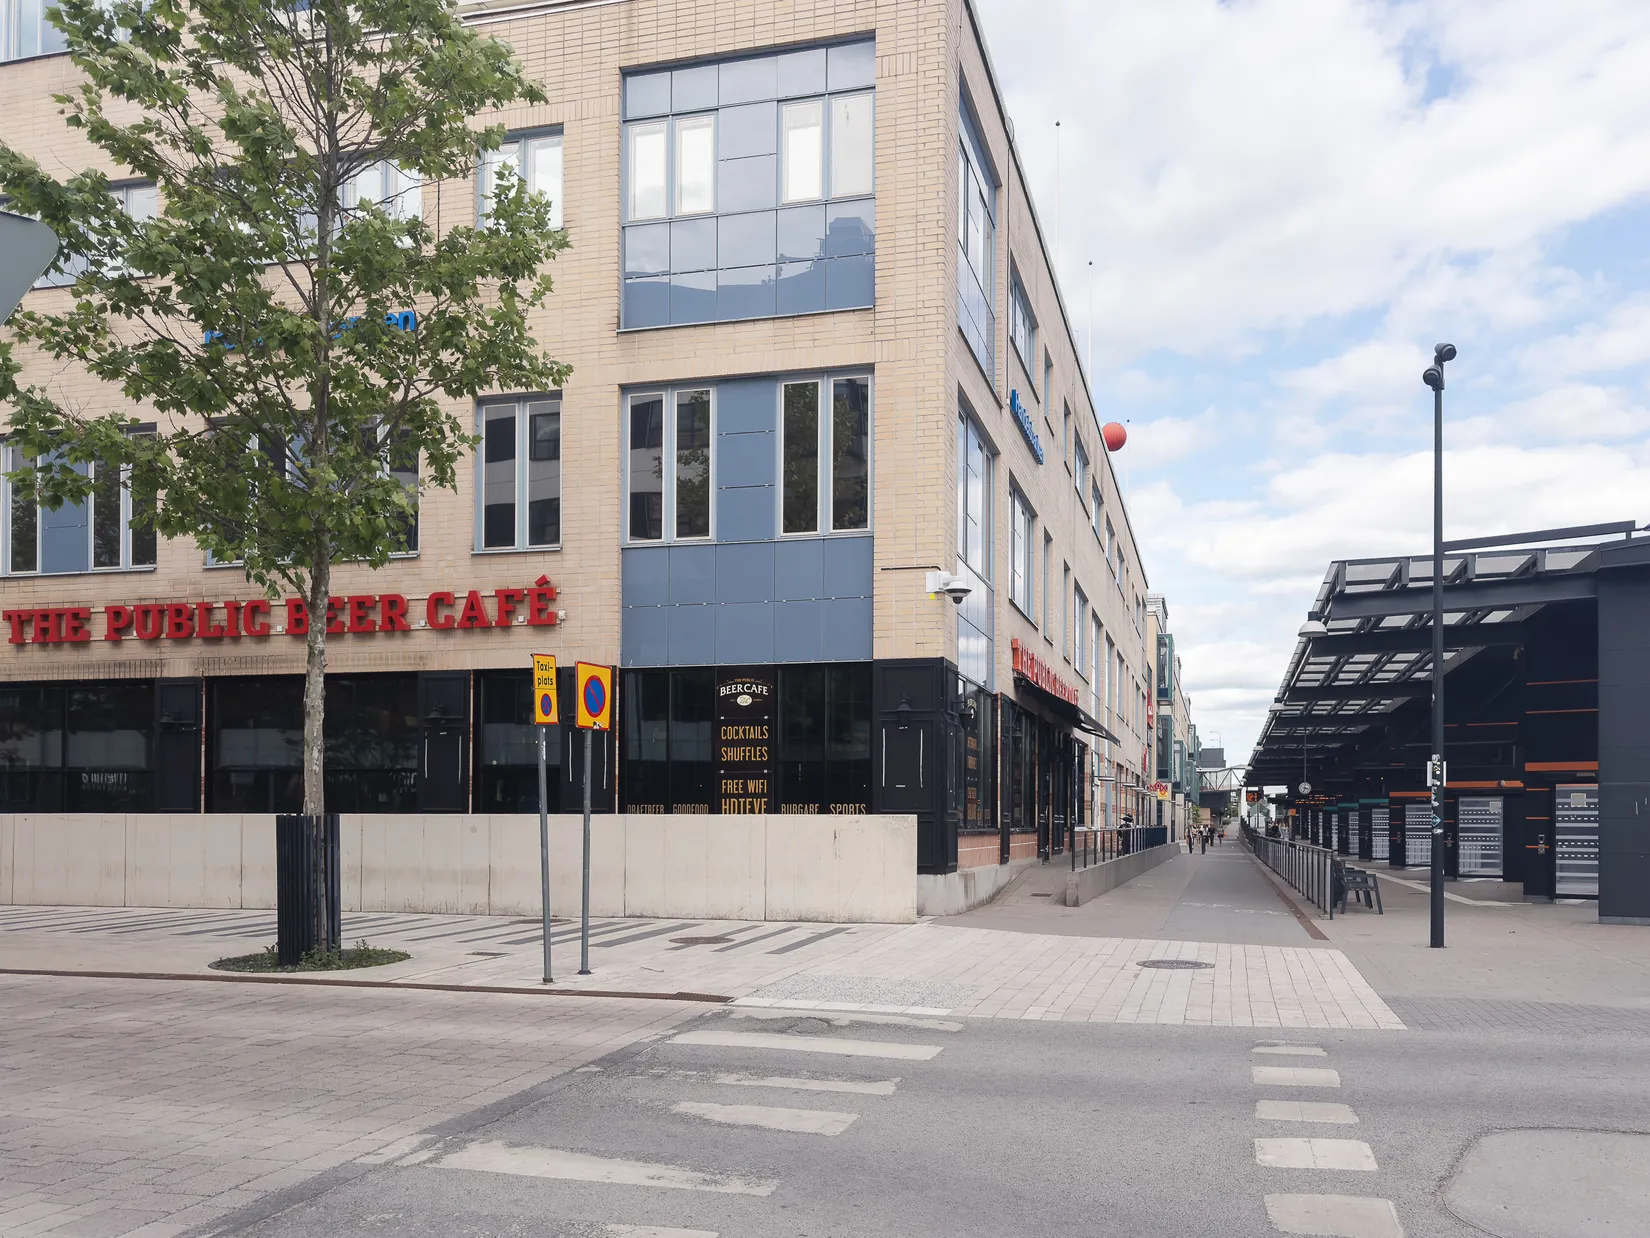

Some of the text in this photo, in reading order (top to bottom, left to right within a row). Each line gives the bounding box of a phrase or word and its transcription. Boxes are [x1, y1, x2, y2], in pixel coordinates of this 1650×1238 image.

[2, 574, 557, 644] THE PUBLIC BEER CAFÉ
[536, 660, 553, 671] Taxi-
[537, 675, 554, 687] plats
[721, 725, 769, 740] COCKTAILS
[721, 746, 768, 761] SHUFFLES
[721, 779, 767, 794] FREE WIFI
[829, 803, 866, 815] SPORTS
